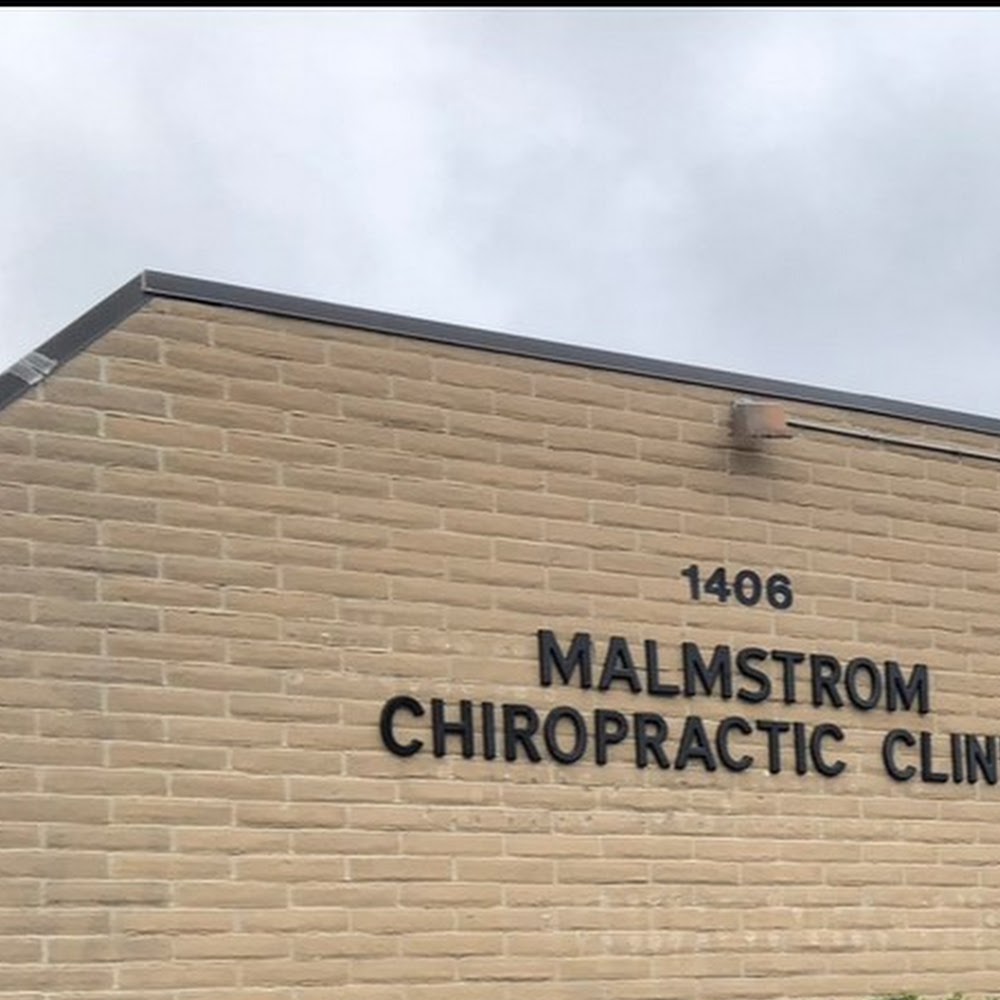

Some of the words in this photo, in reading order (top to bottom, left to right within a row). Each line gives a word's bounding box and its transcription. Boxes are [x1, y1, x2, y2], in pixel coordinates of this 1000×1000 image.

[681, 564, 793, 610] 1406
[536, 629, 931, 717] MALMSTROM
[378, 695, 846, 779] CHIROPRACTIC
